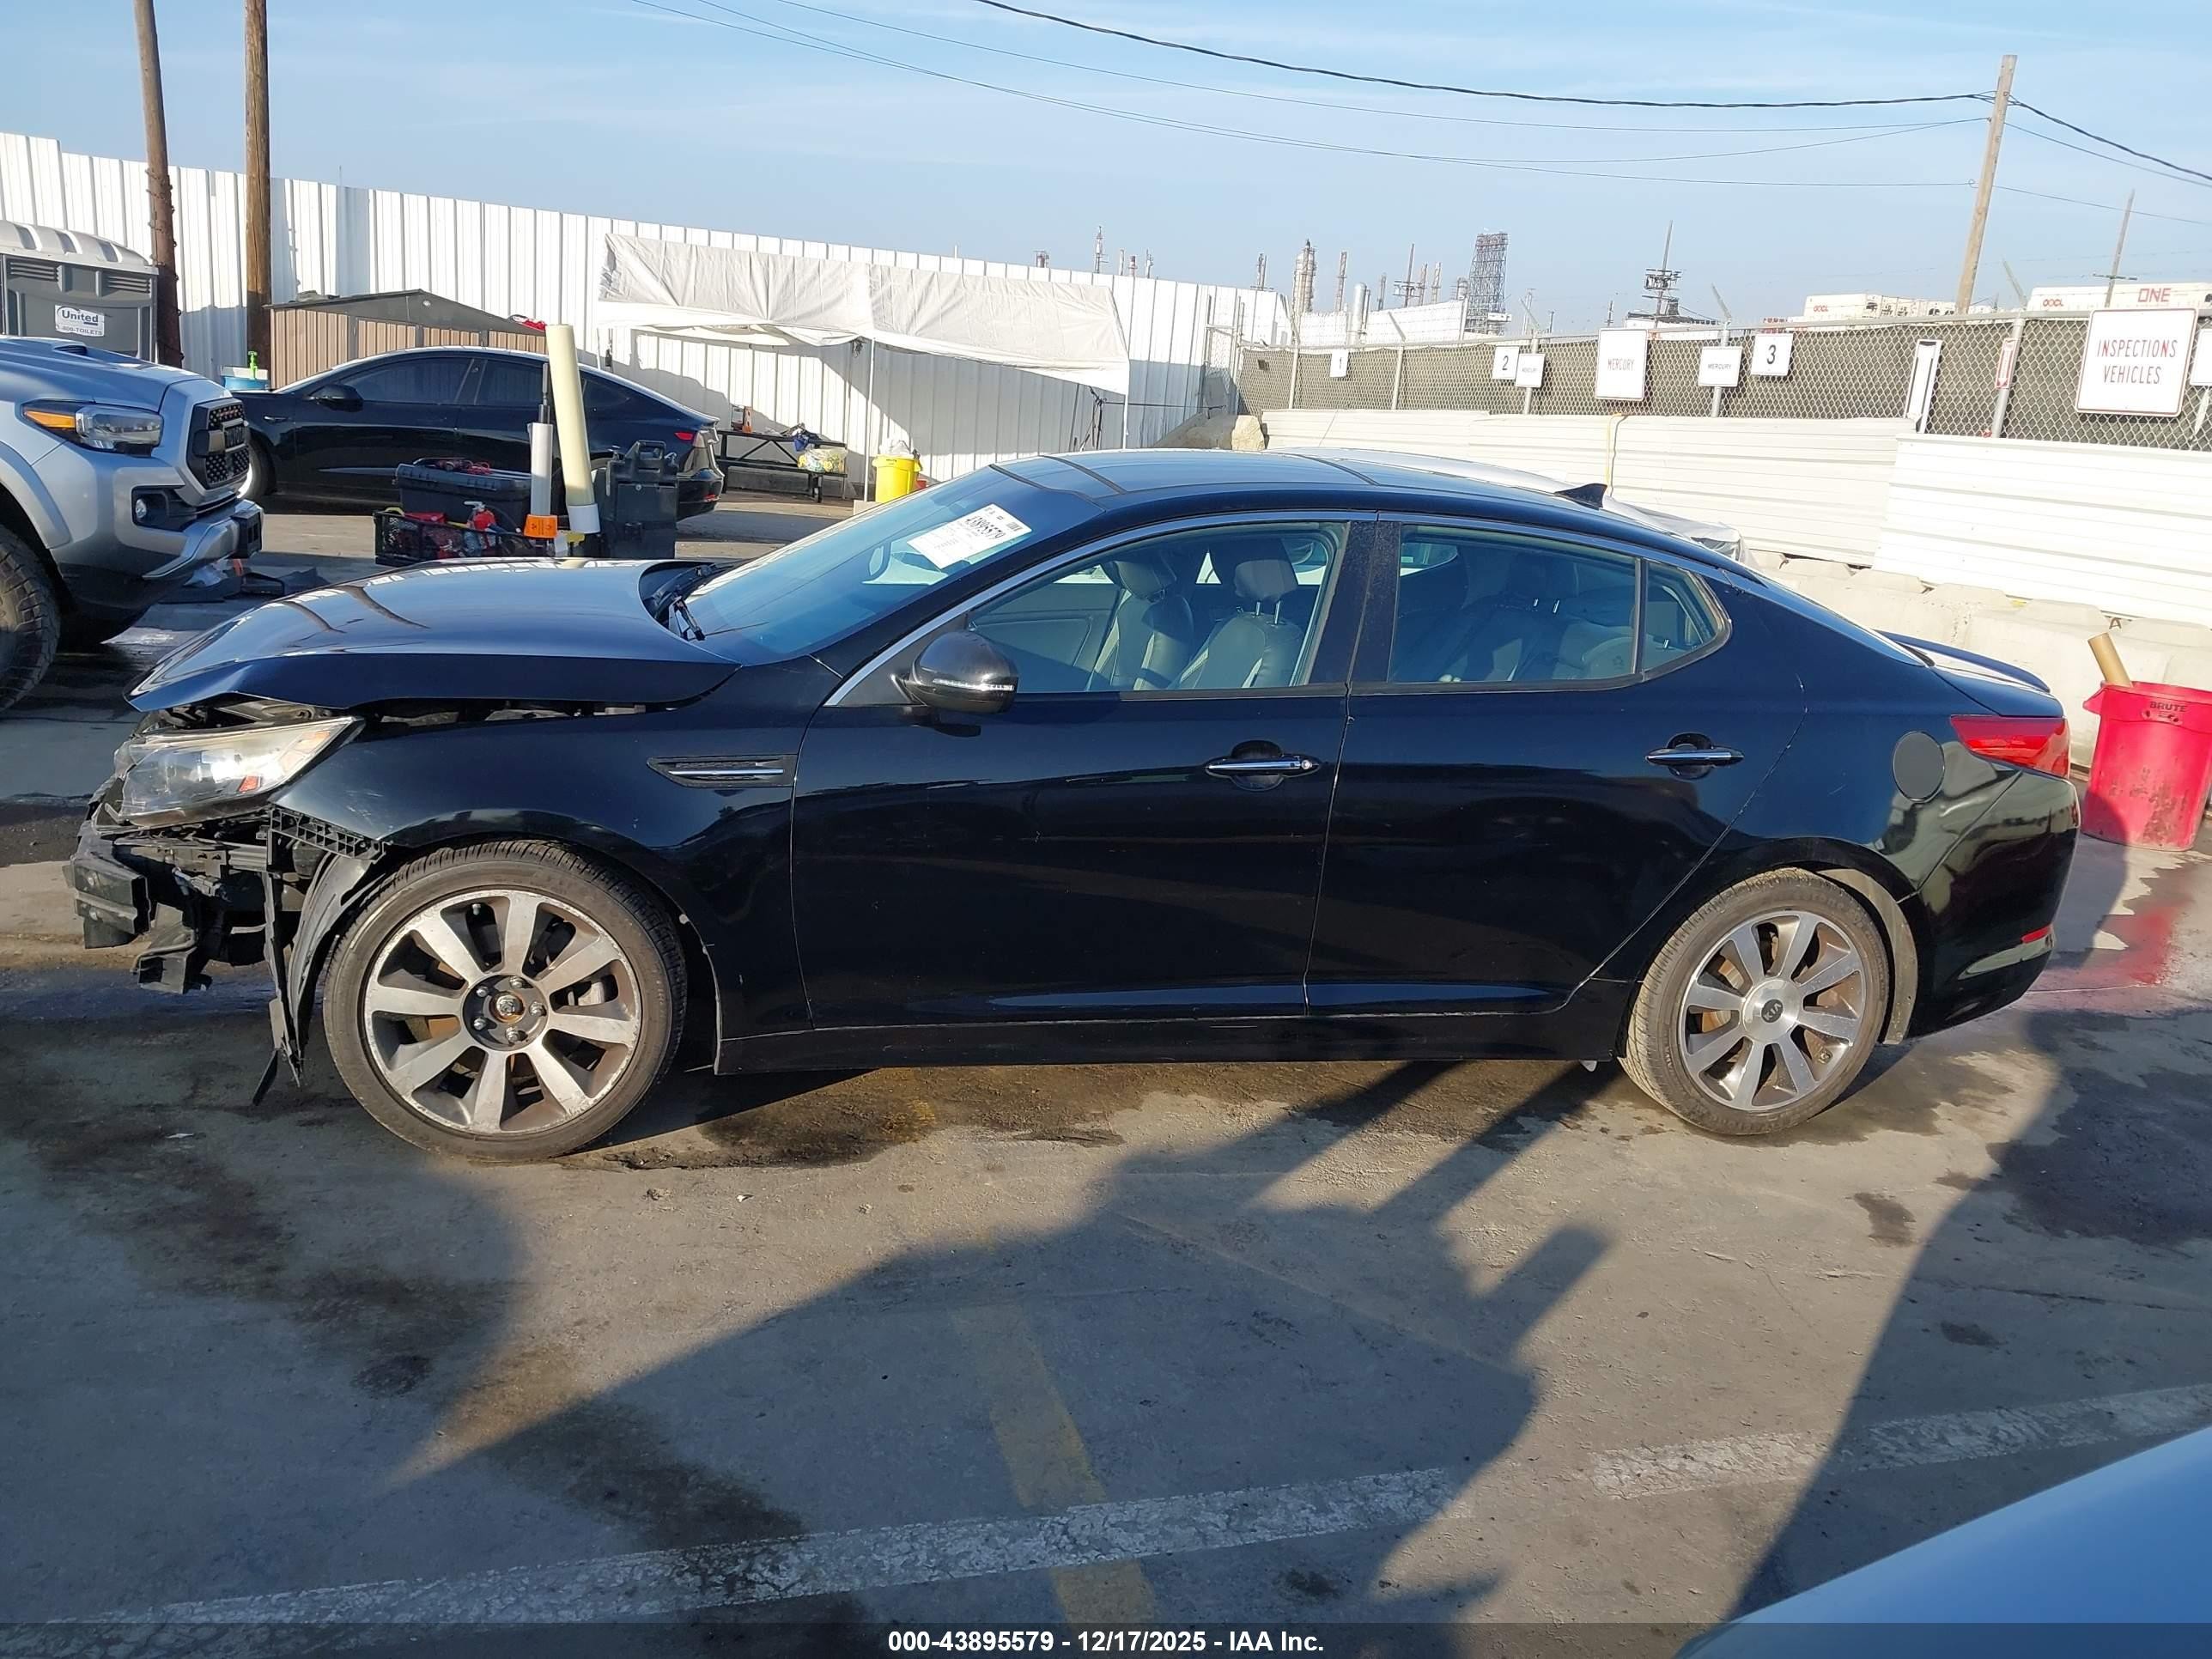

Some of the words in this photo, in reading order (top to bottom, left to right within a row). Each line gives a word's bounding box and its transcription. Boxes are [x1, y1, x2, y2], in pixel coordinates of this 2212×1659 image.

[2137, 288, 2172, 303] ONE
[61, 309, 99, 323] United
[1766, 344, 1777, 365] 3
[2097, 339, 2179, 358] INSPECTIONS
[1502, 355, 1510, 371] 2
[1607, 357, 1635, 371] MERCURY
[2104, 366, 2162, 385] VEHICLES
[2149, 701, 2187, 713] BRUTE
[1764, 1003, 1782, 1021] KIA
